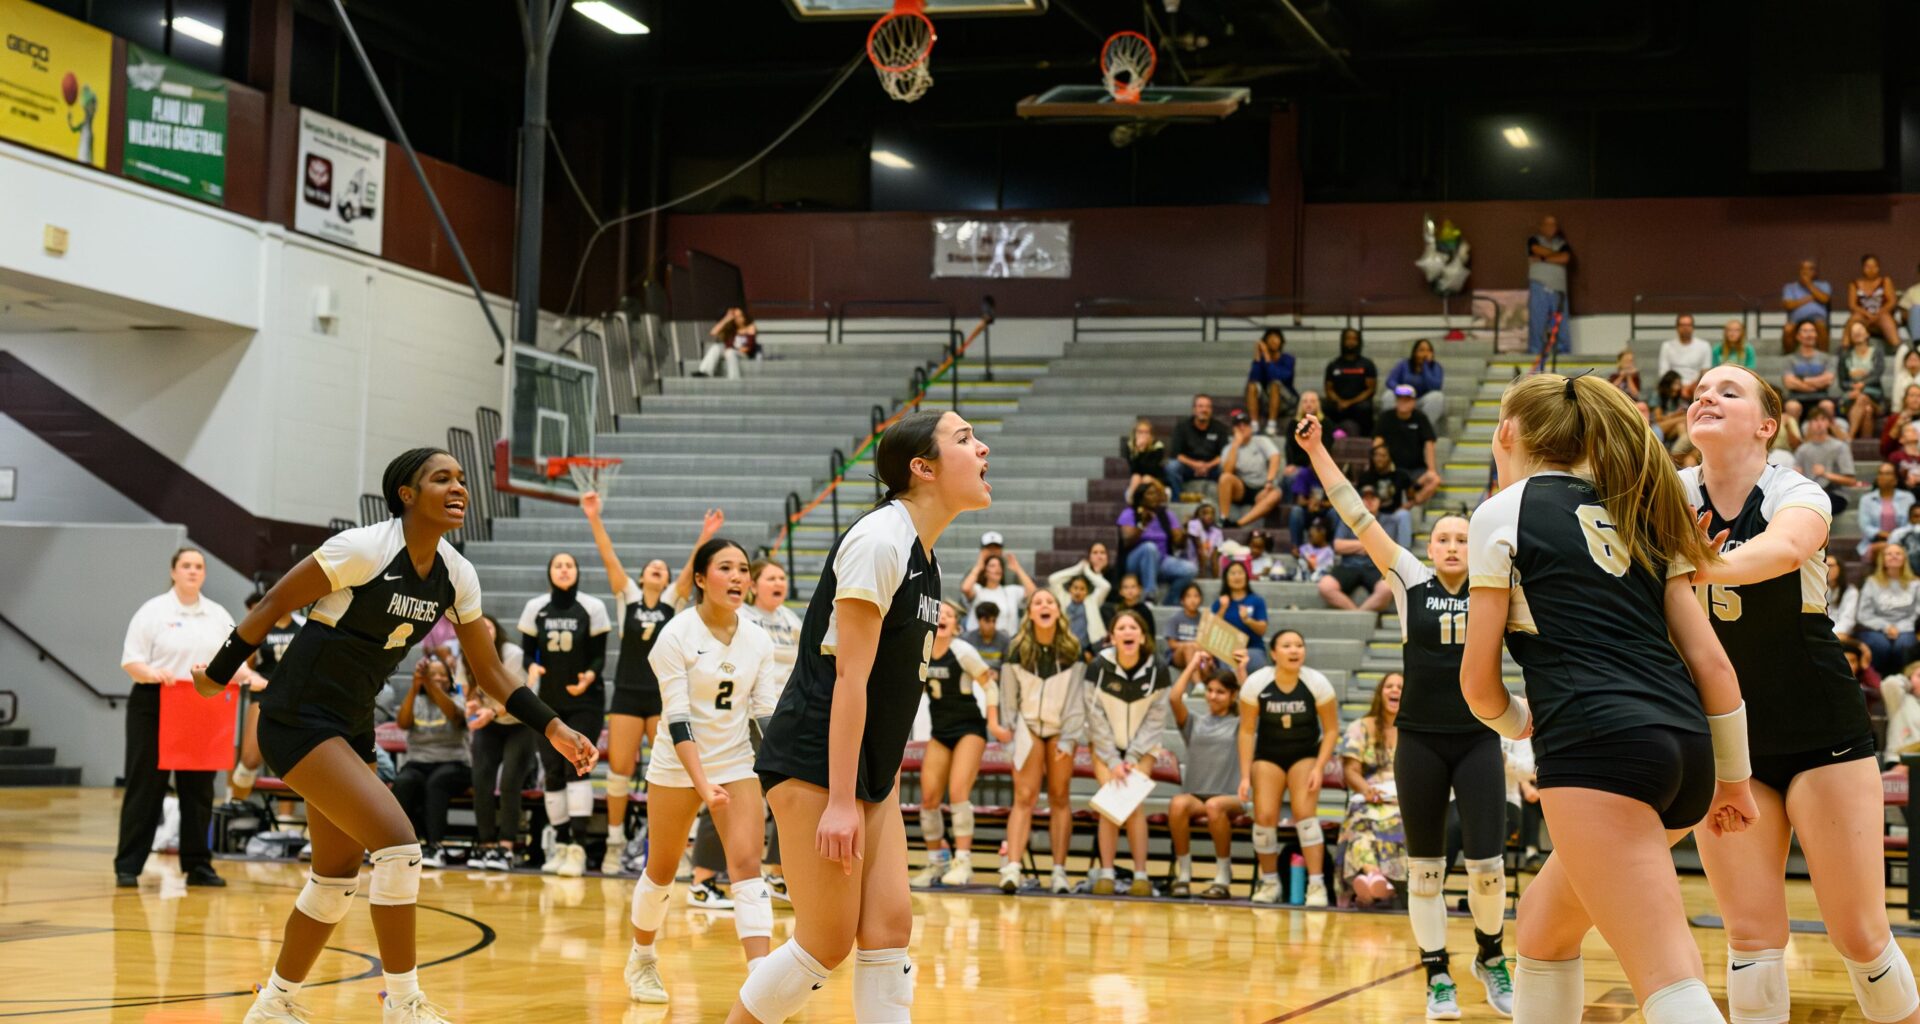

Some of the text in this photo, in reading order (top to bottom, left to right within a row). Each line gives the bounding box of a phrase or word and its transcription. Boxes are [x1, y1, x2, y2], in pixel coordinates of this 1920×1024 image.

[7, 33, 49, 62] GEICO
[1574, 504, 1631, 577] 6
[386, 592, 439, 622] PANTHERS
[916, 592, 941, 627] PANTHE
[1425, 597, 1470, 612] PANTHE
[1695, 584, 1742, 622] 15
[546, 630, 573, 652] 20
[640, 621, 657, 641] 7
[1438, 611, 1467, 645] 11
[715, 680, 735, 711] 2
[1265, 700, 1307, 714] PANTHERS
[1280, 713, 1293, 729] 1
